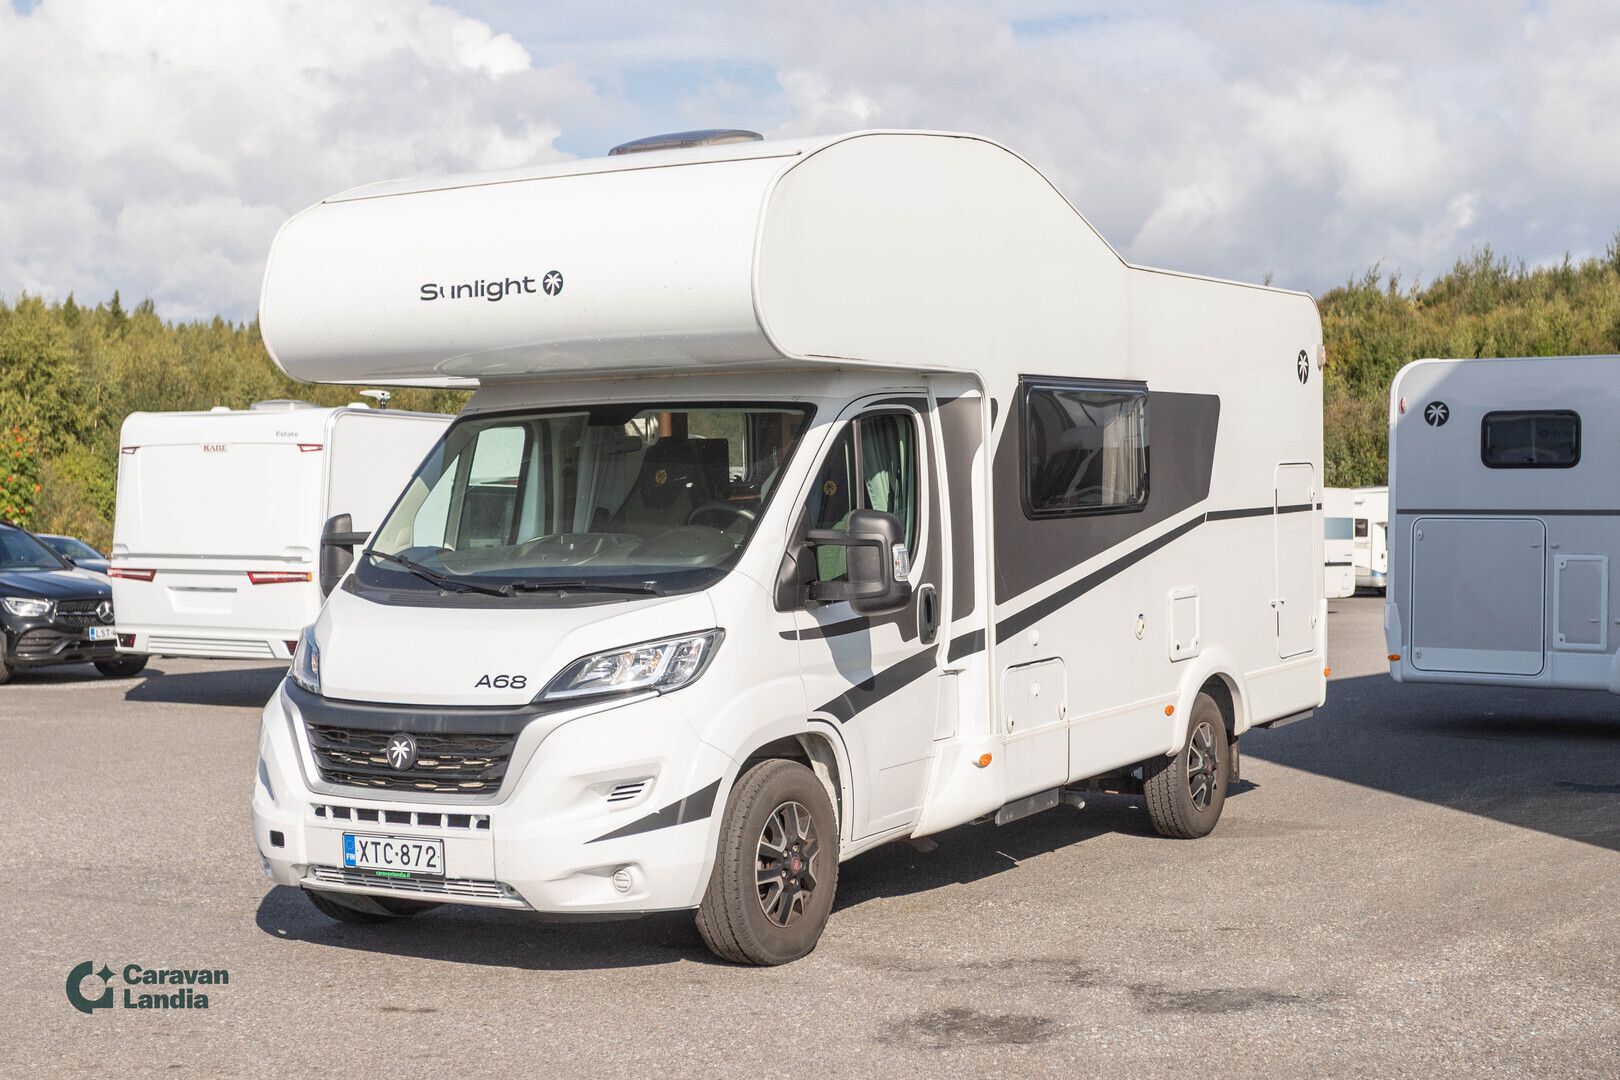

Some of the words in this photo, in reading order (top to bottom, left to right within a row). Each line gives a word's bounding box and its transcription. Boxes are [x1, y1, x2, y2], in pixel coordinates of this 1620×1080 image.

[420, 275, 537, 302] Sunlight
[275, 430, 299, 438] Estate
[203, 444, 227, 453] KABE
[474, 674, 528, 690] A68
[346, 852, 356, 861] FIN
[358, 840, 437, 868] XTC-872
[375, 870, 411, 879] caravanlandia.fi
